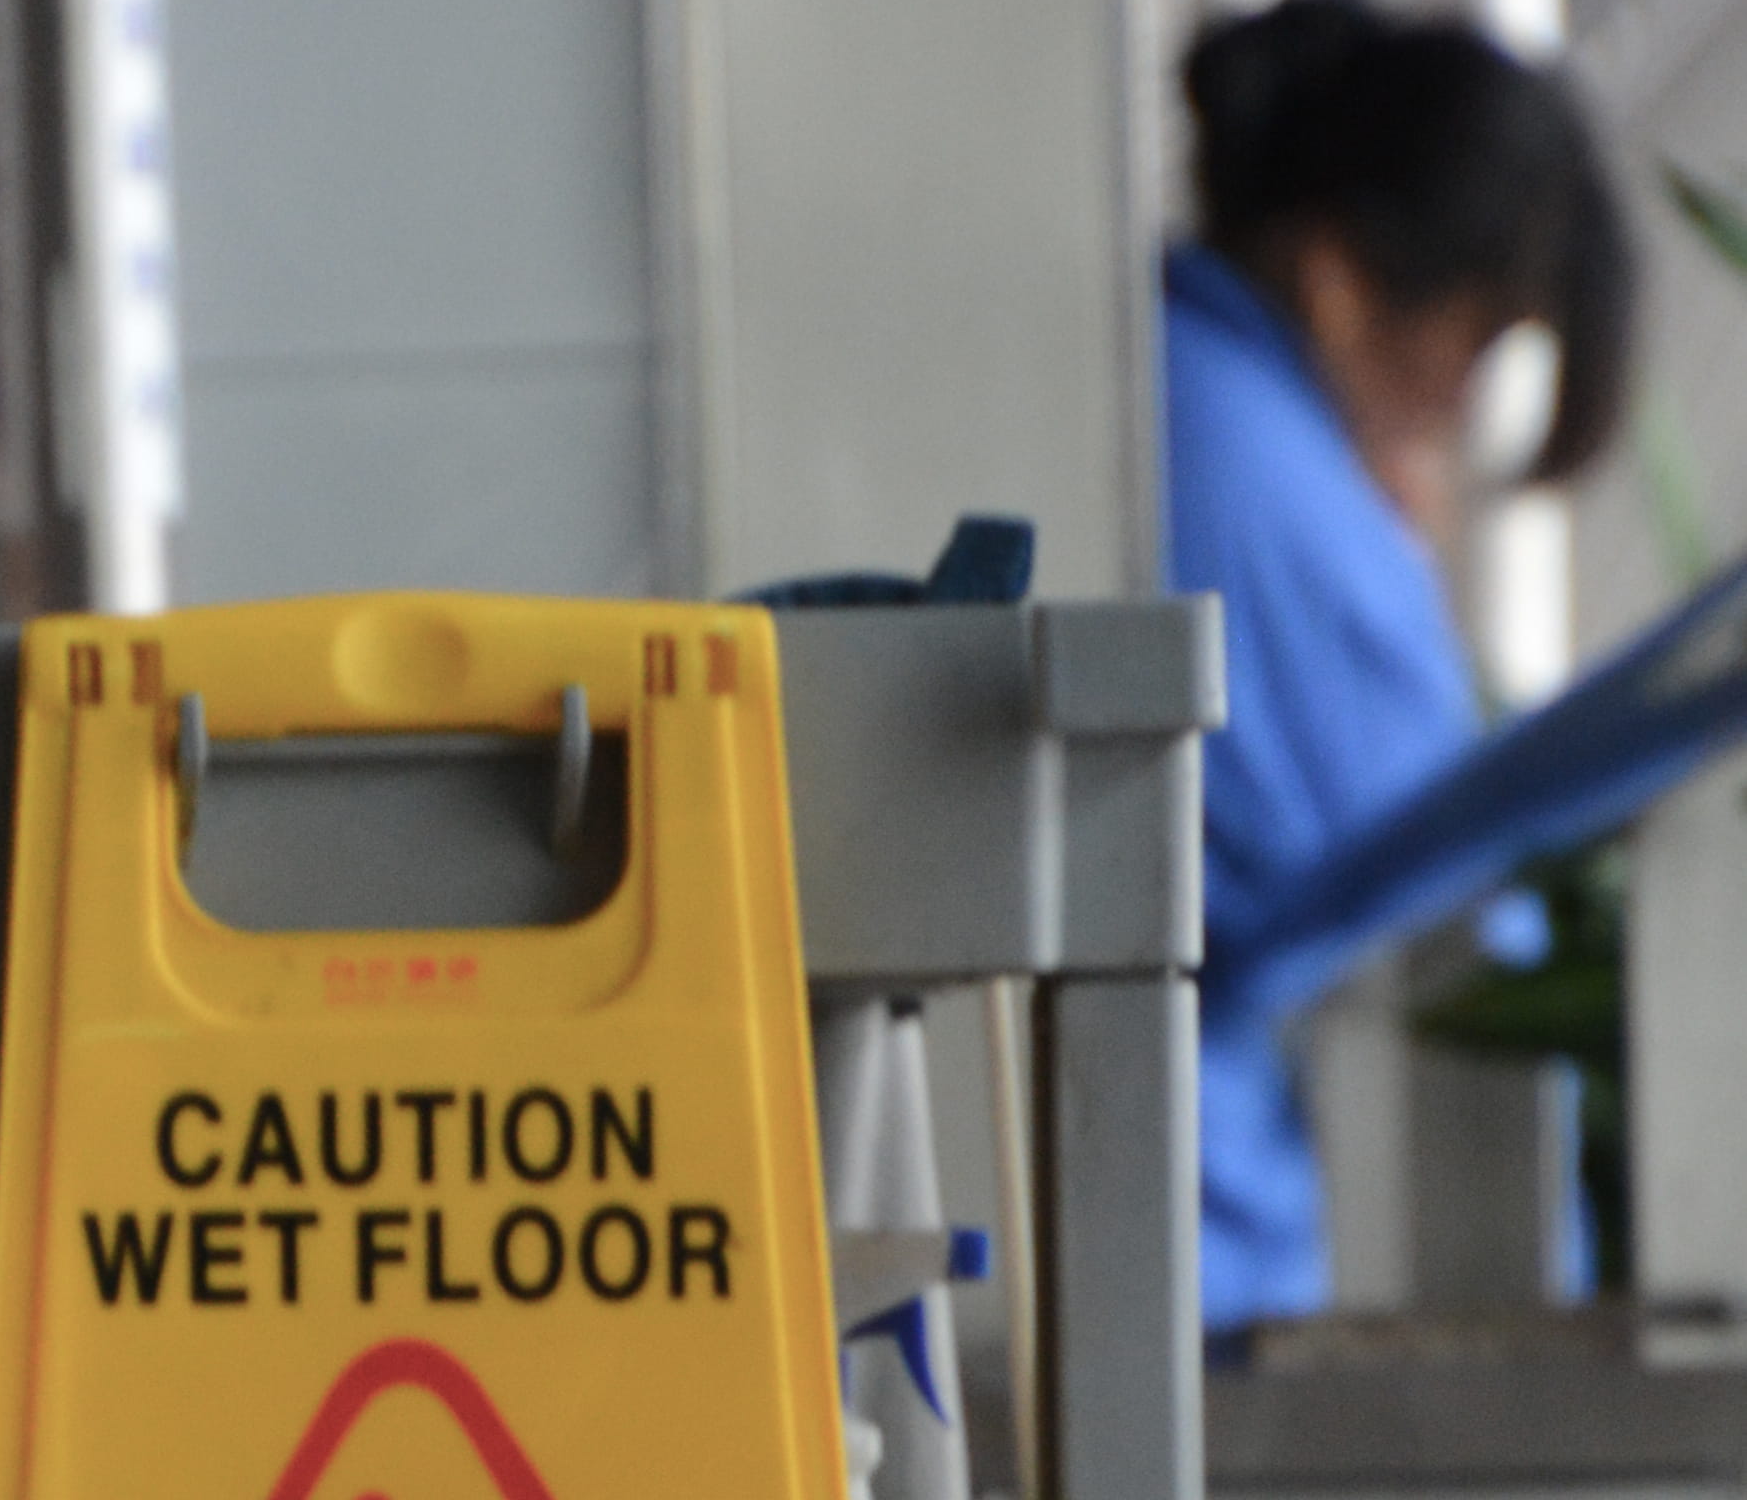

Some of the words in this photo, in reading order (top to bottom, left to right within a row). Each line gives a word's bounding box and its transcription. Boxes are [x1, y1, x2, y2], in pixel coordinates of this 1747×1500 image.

[156, 1087, 655, 1189] CAUTION
[83, 1210, 320, 1305] WET
[356, 1203, 731, 1303] FLOOR
